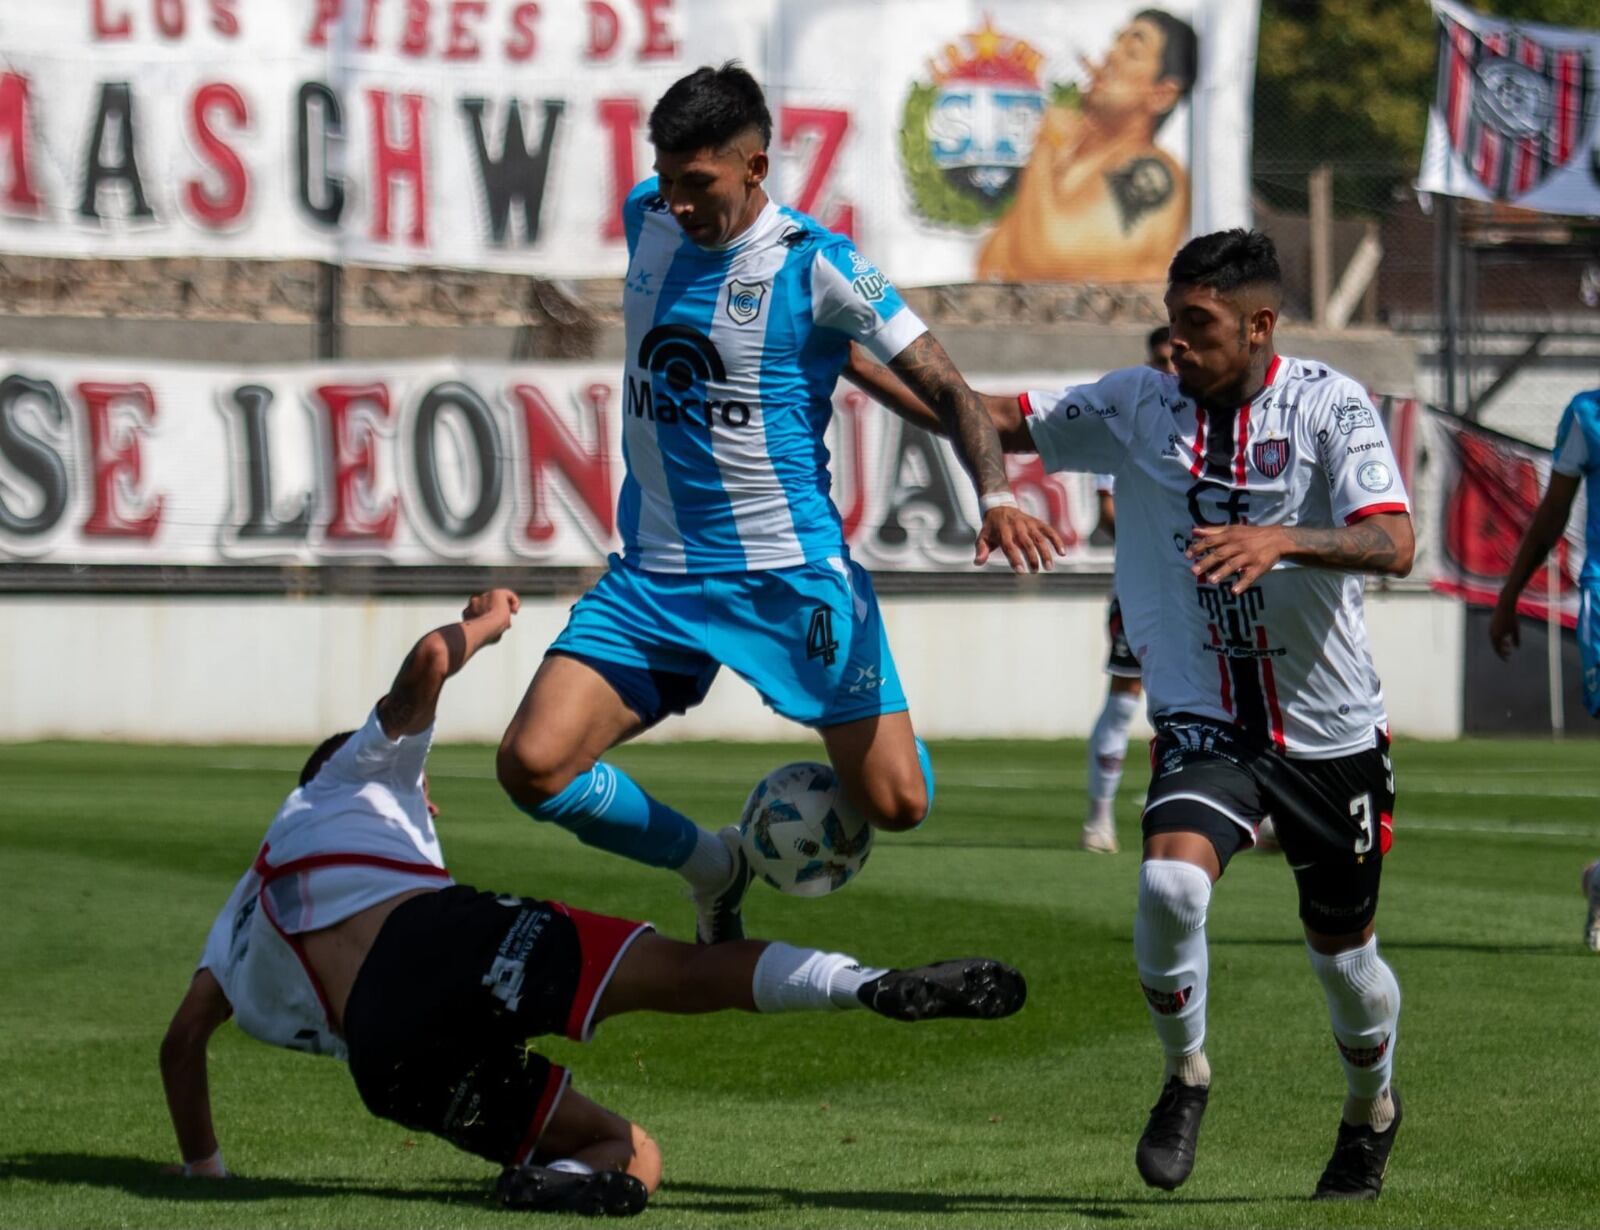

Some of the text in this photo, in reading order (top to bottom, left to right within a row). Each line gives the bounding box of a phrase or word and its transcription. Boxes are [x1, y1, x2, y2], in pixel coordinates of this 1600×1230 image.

[307, 0, 540, 61] PIBES
[586, 0, 678, 59] DE
[0, 71, 856, 250] ASCHWIZ
[628, 376, 750, 428] Macro
[233, 380, 615, 544] LEON
[805, 604, 839, 668] 4
[1349, 793, 1374, 855] 3
